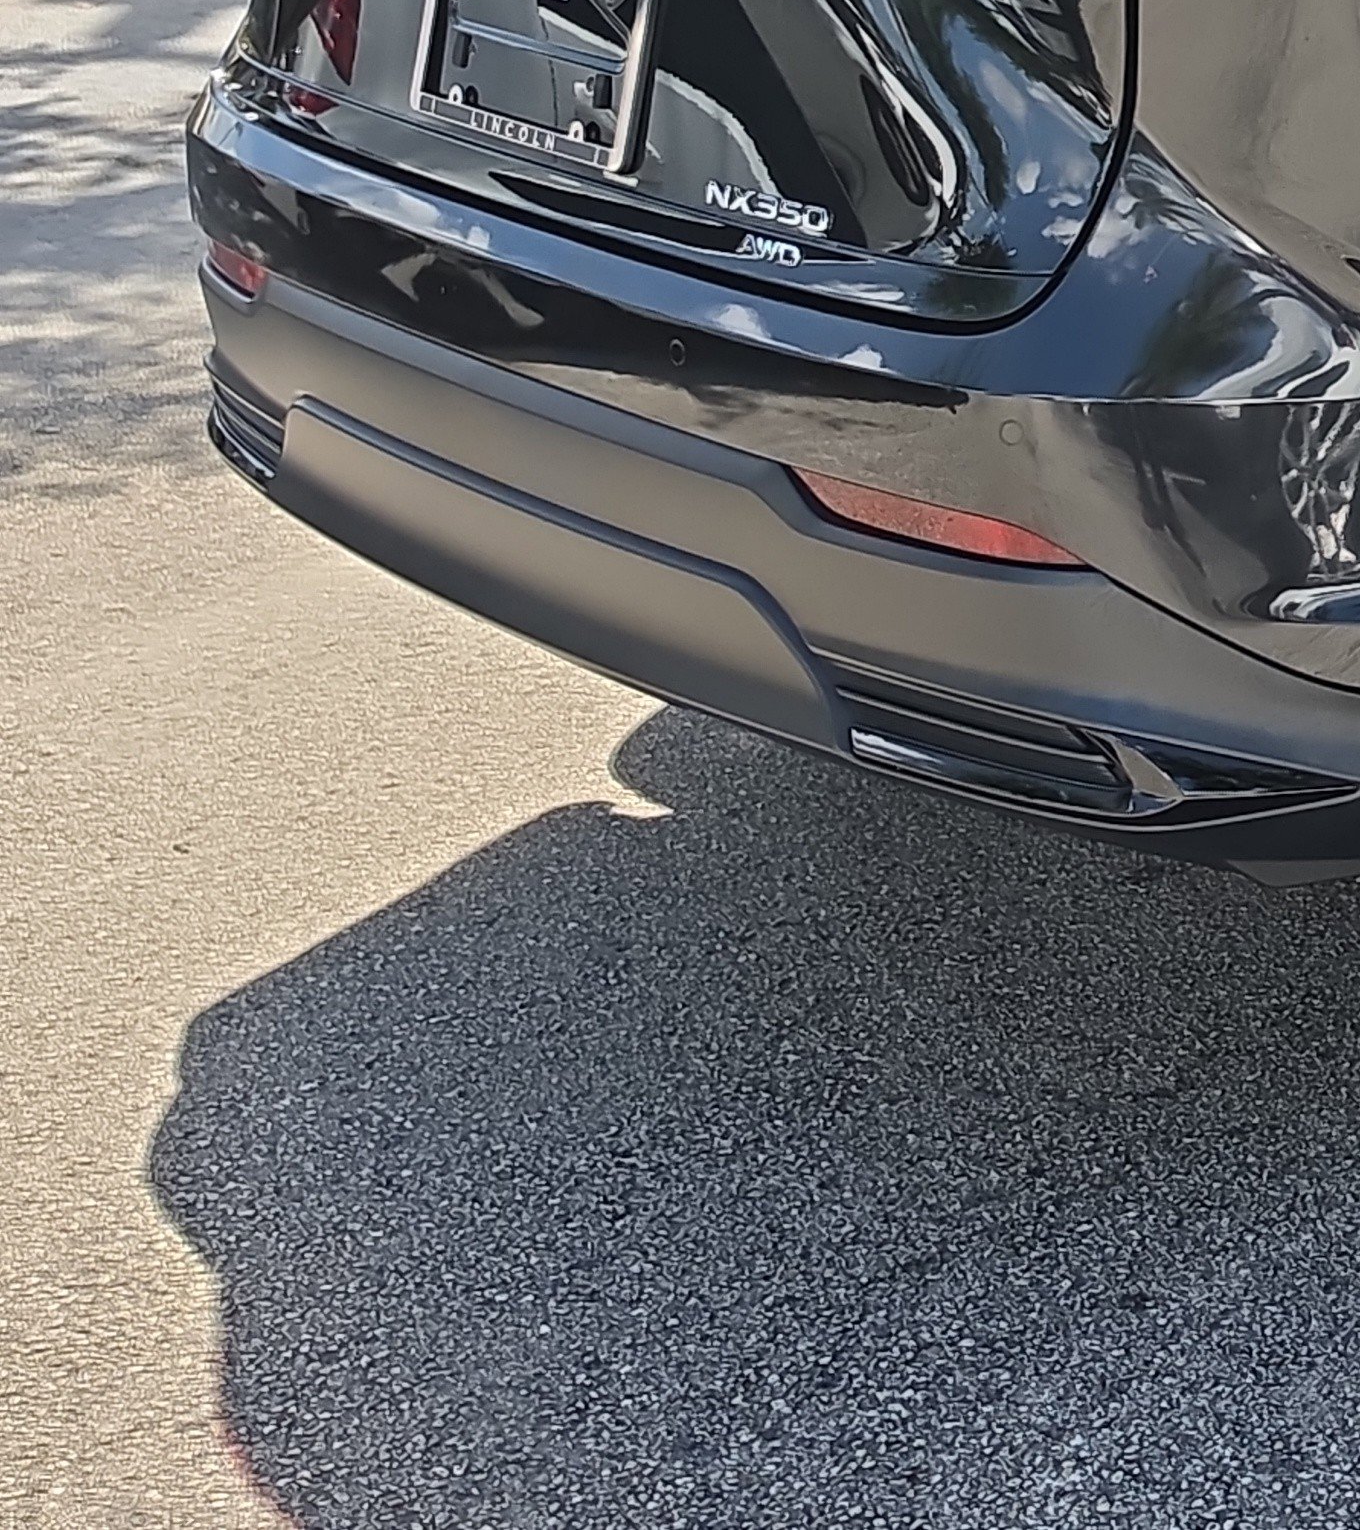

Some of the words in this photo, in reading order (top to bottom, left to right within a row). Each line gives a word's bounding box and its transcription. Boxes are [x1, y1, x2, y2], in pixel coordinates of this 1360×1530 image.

[470, 111, 556, 151] LINCOLN
[705, 180, 832, 235] NX350
[736, 233, 802, 268] AWD
